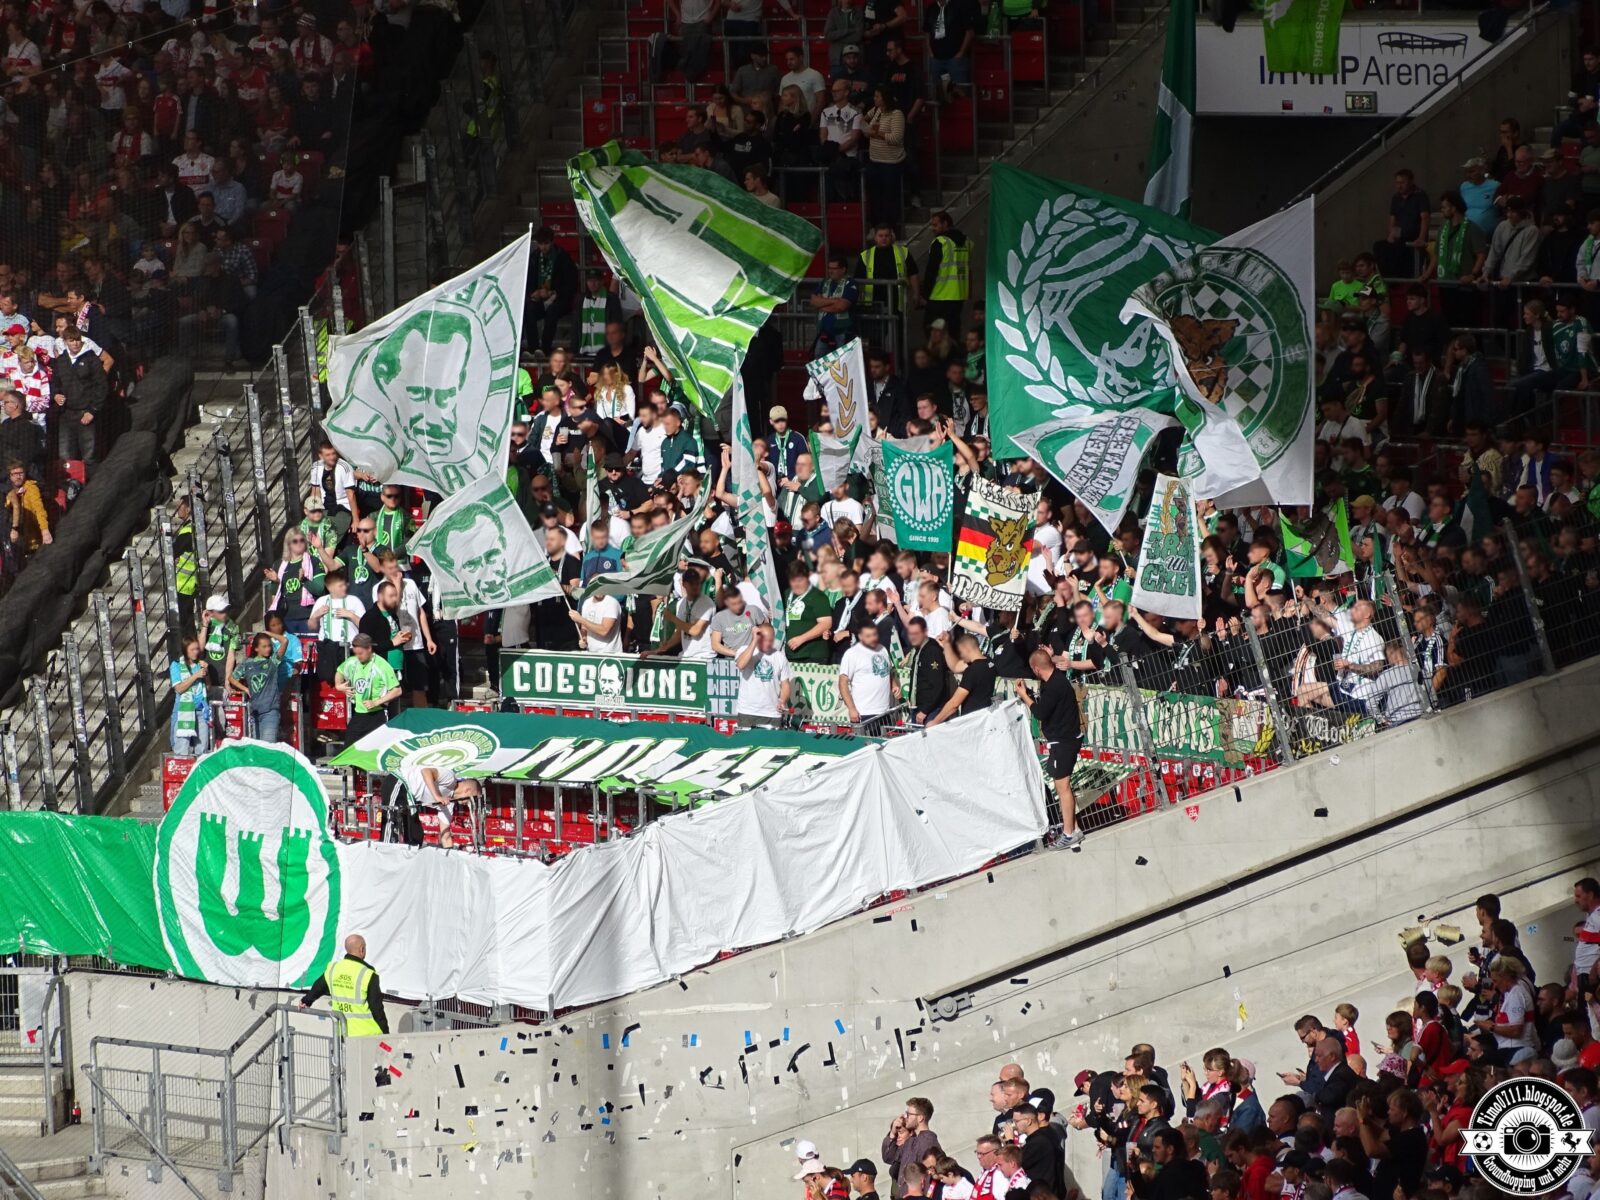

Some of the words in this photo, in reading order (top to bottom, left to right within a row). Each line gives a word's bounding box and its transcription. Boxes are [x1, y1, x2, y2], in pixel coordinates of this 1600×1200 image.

[1313, 0, 1330, 68] OLFSBURG
[894, 461, 947, 522] GWA
[909, 534, 927, 543] SINCE
